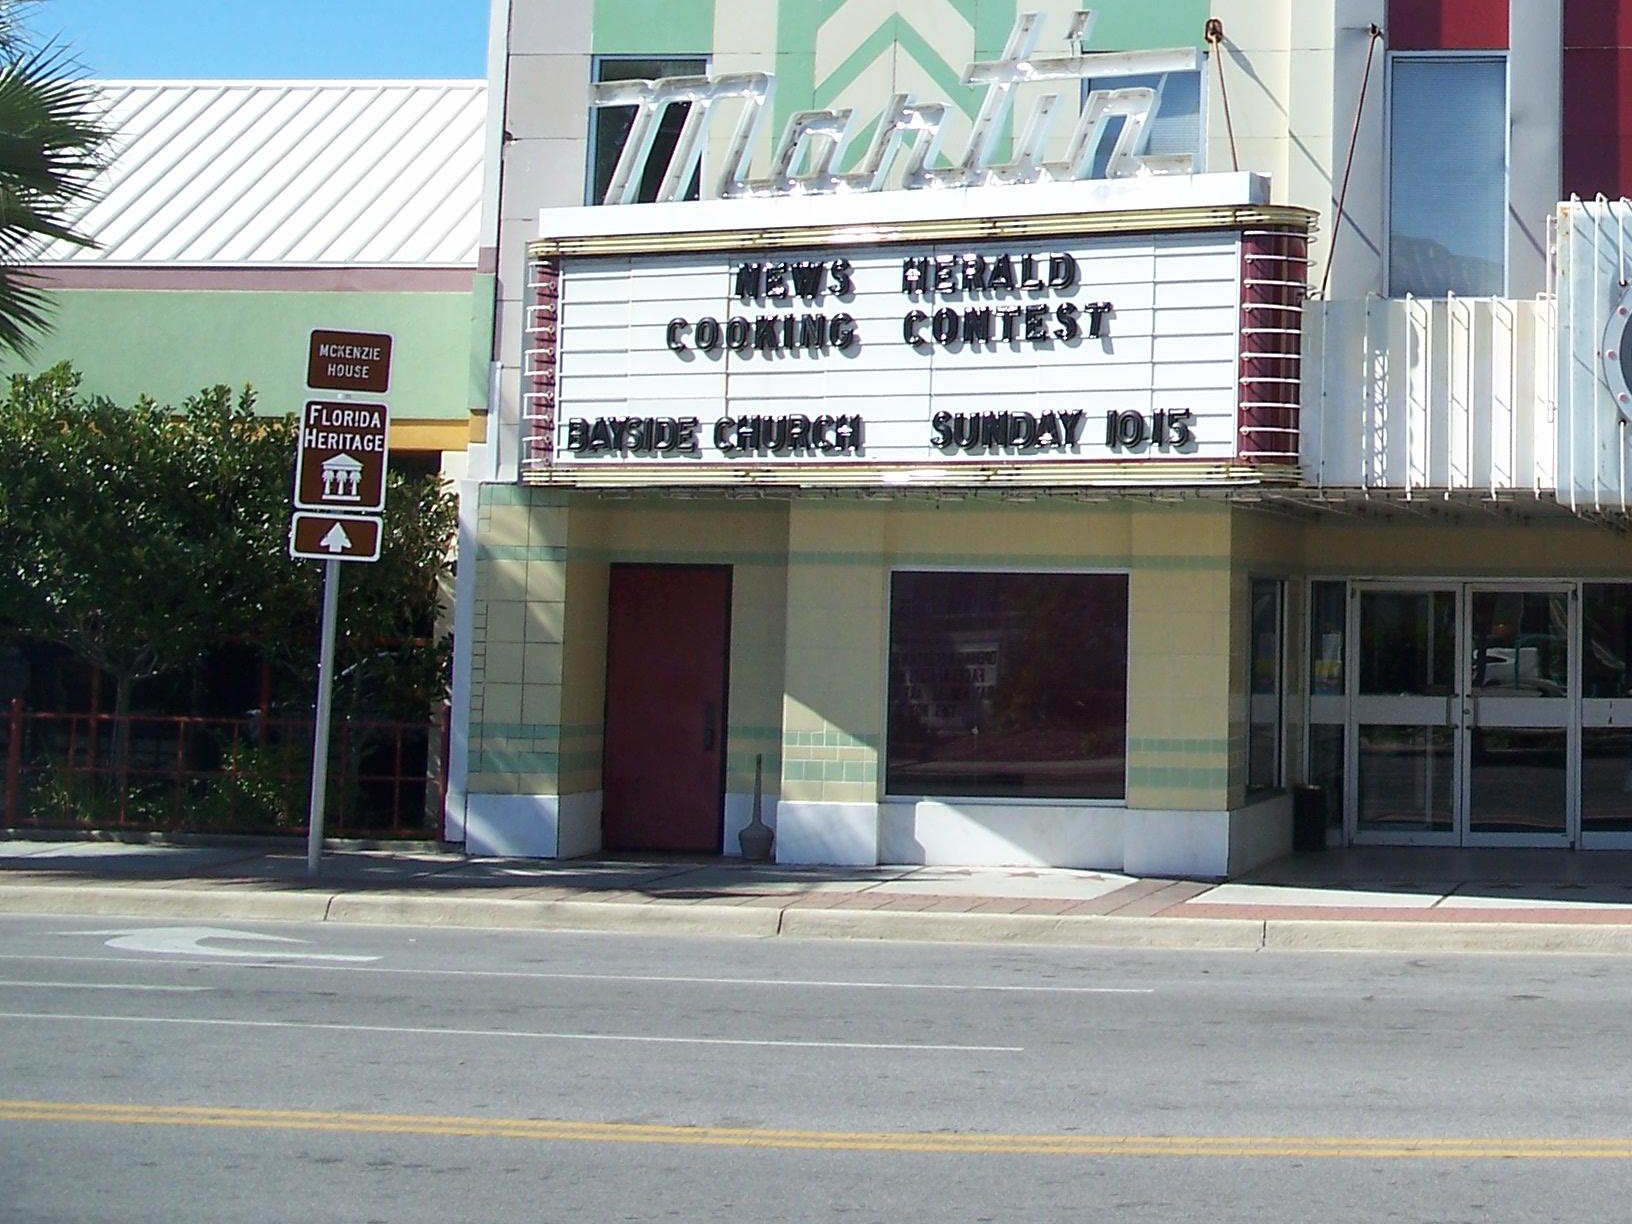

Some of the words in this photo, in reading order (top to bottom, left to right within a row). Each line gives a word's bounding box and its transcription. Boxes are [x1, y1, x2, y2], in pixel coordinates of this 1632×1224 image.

[588, 9, 1198, 206] Martin
[735, 259, 850, 300] NEWS
[902, 253, 1075, 295] HERALD
[667, 314, 854, 353] COOKING
[904, 303, 1111, 347] CONTEST
[319, 343, 381, 361] MCKENZIE
[327, 363, 370, 379] HOUSE
[567, 417, 698, 453] BAYSIDE
[714, 415, 861, 454] CHURCH
[931, 410, 1082, 450] SUNDAY
